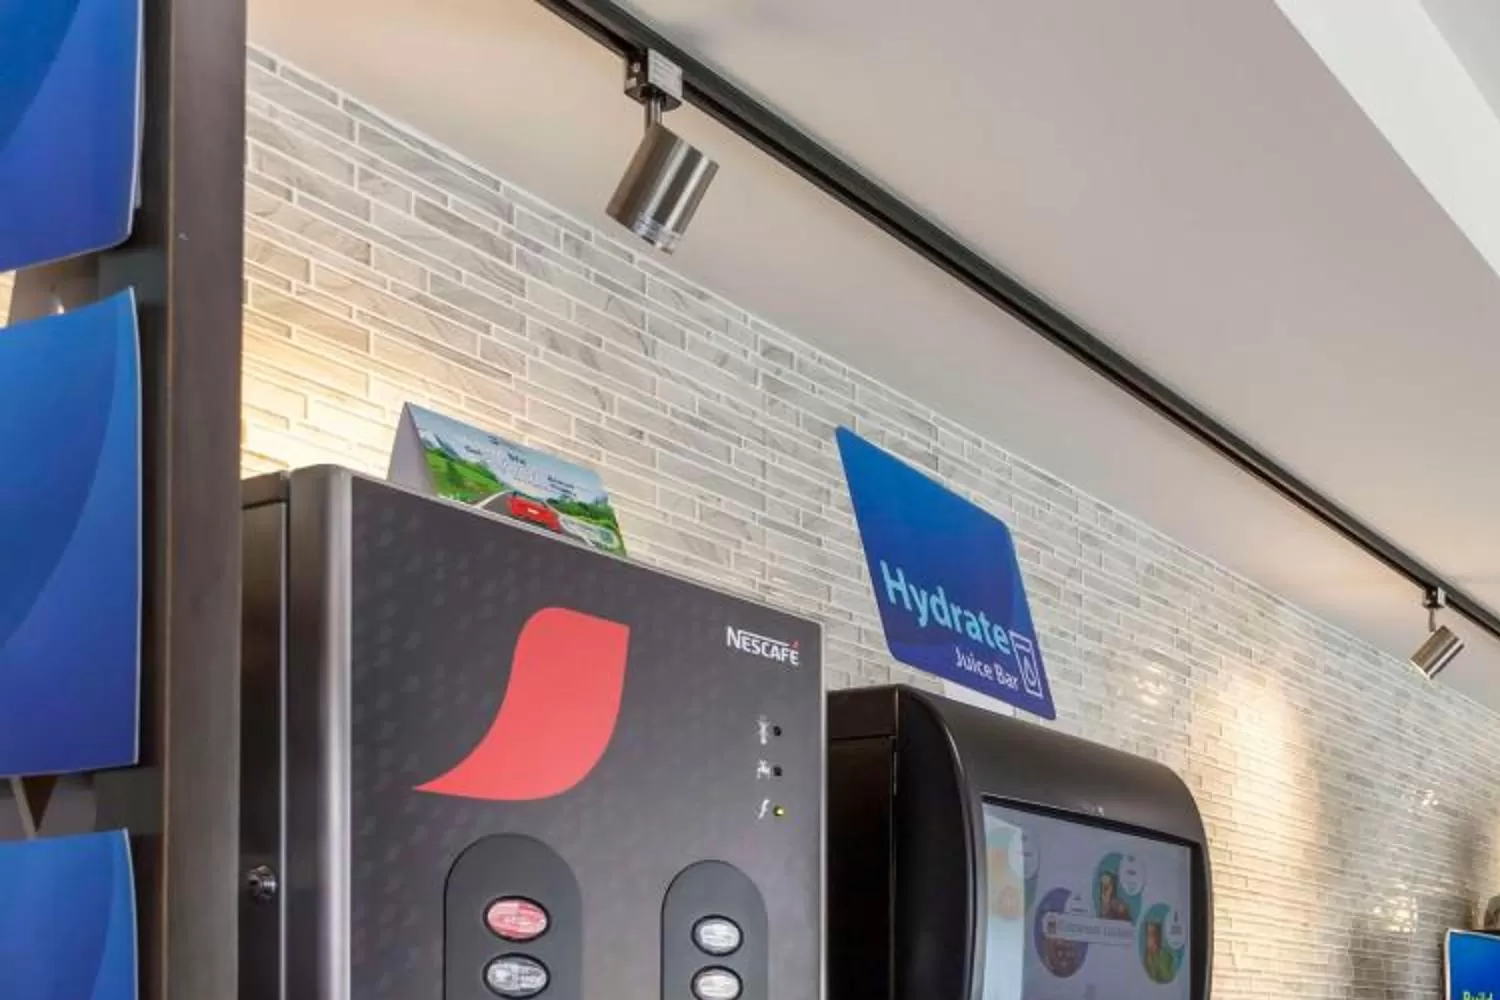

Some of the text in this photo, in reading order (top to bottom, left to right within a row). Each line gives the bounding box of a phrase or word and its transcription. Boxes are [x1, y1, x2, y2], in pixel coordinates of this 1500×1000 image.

[880, 559, 1012, 655] Hydrate
[955, 647, 1019, 691] Juice Bar
